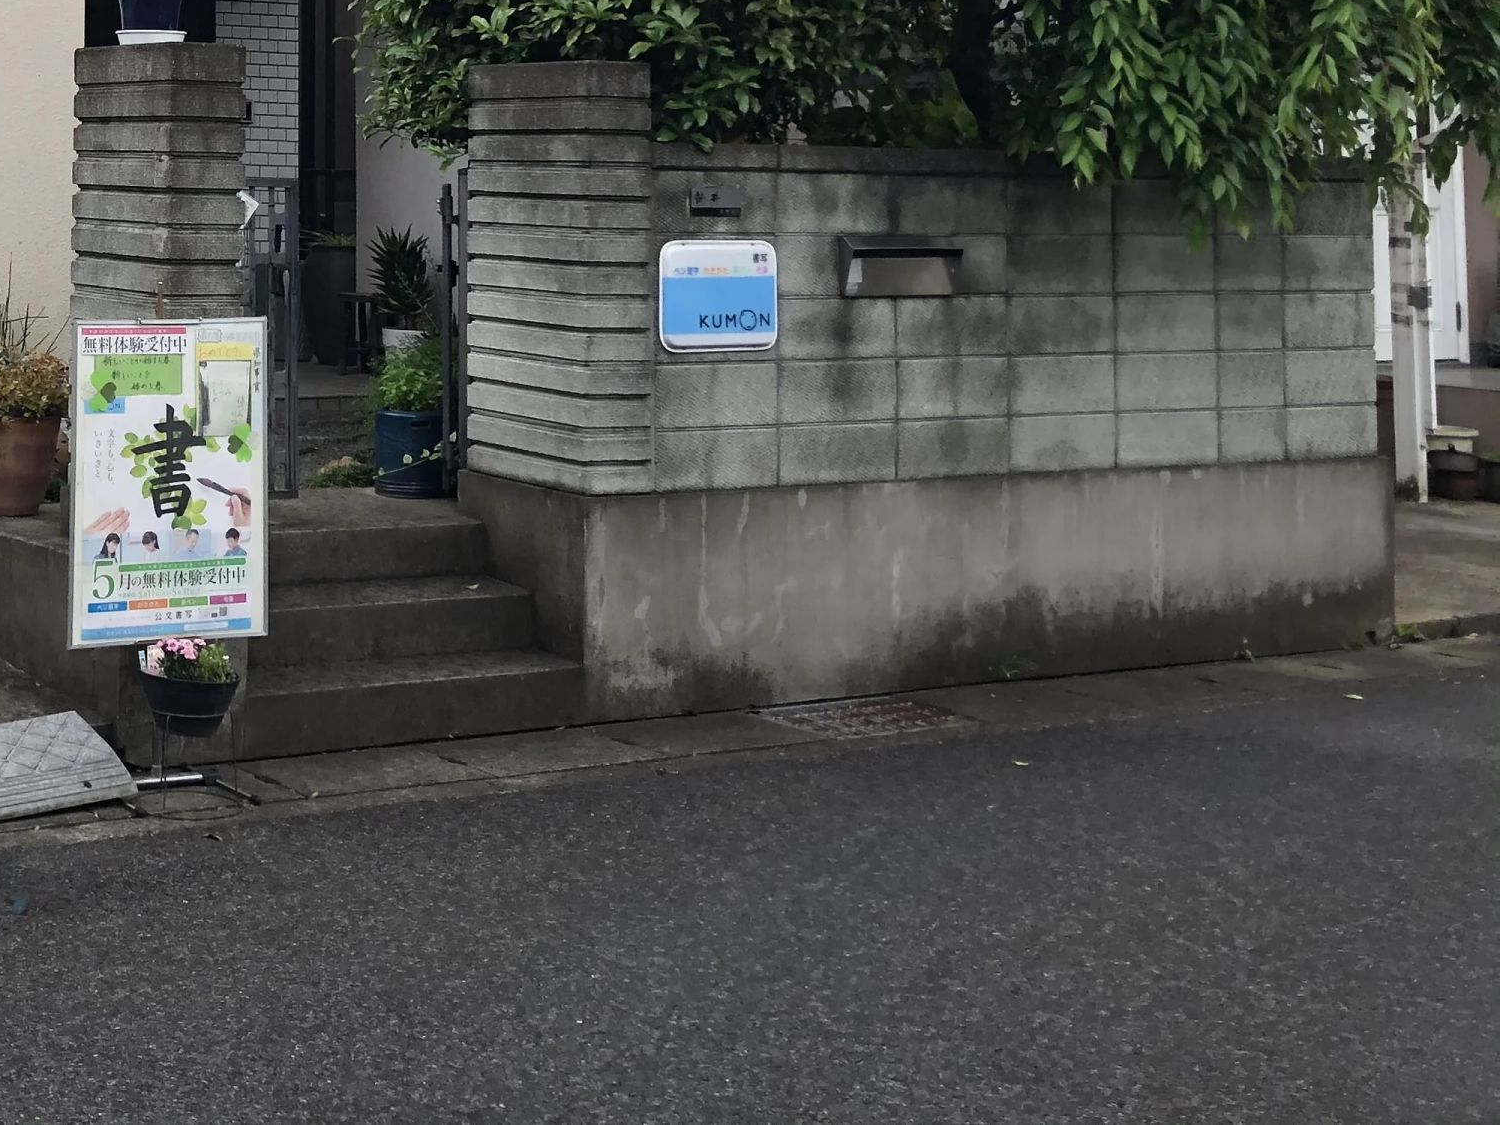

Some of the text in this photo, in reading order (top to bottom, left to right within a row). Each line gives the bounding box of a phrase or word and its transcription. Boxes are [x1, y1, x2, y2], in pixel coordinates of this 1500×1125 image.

[699, 309, 771, 331] KUMON
[82, 336, 187, 353] 無料体験受付中
[131, 404, 206, 518] 書
[155, 609, 193, 621] 公文書写
